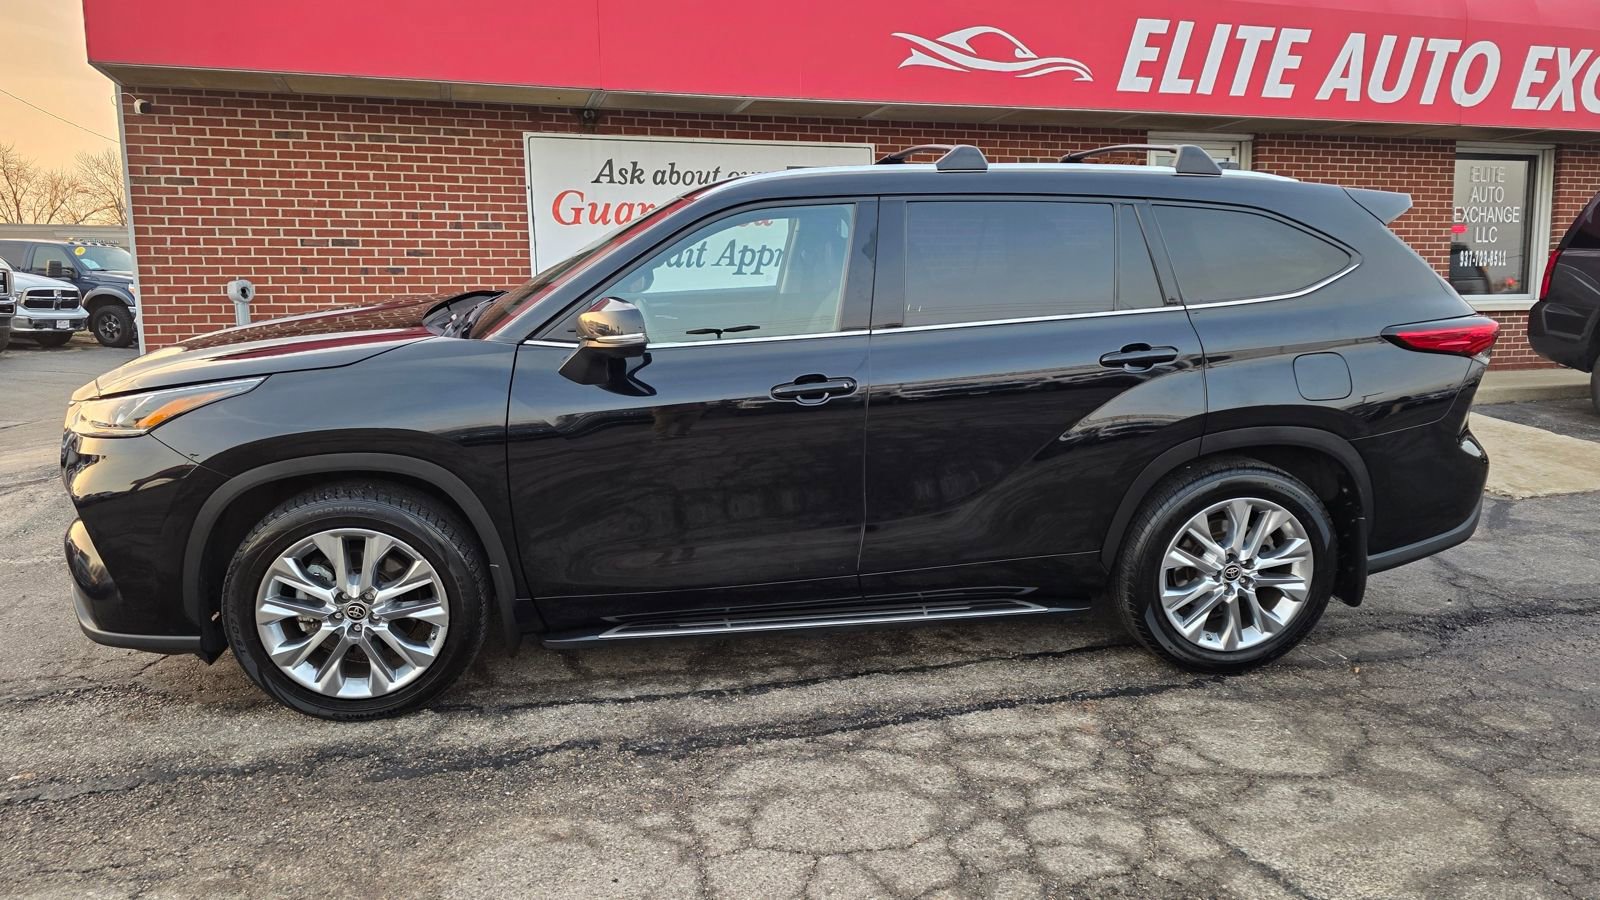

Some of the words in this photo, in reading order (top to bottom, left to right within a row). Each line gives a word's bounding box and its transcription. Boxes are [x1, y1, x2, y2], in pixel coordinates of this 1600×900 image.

[1116, 18, 1312, 99] ELITE
[1315, 32, 1501, 107] AUTO
[590, 158, 646, 185] Ask
[652, 163, 721, 186] about
[1471, 166, 1505, 182] ELITE
[1470, 186, 1505, 203] AUTO
[1453, 206, 1520, 223] EXCHANGE
[1475, 226, 1498, 243] LLC
